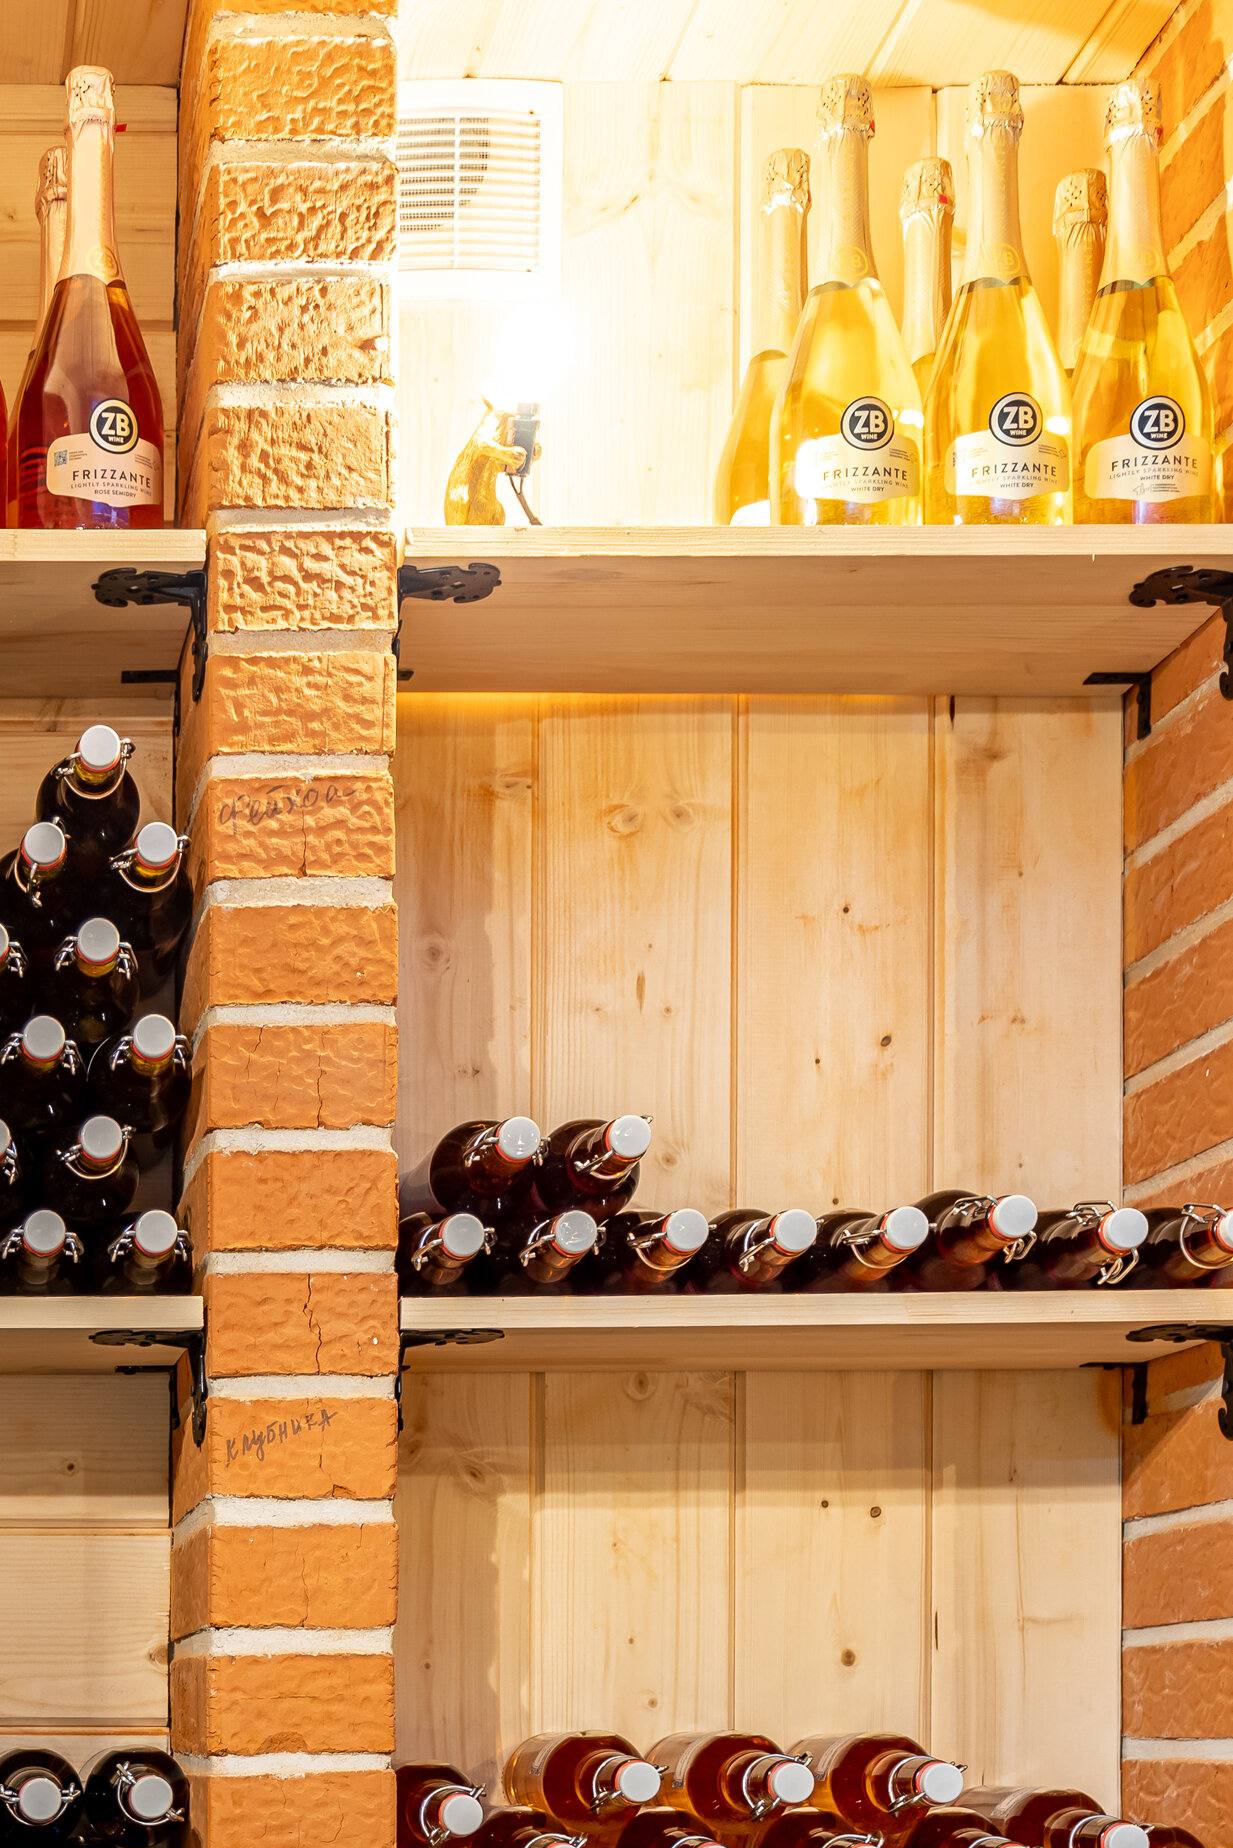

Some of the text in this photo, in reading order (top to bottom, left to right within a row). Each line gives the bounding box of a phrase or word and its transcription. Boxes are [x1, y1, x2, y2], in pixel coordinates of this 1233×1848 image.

[101, 412, 131, 437] ZB
[853, 410, 885, 434] ZB
[1002, 406, 1035, 430] ZB
[1142, 409, 1175, 433] ZB
[108, 435, 124, 444] WINE
[823, 466, 908, 481] FRIZZANTE
[971, 462, 1057, 478] FRIZZANTE
[1111, 454, 1198, 472] FRIZZANTE
[72, 468, 151, 489] FRIZZANTE
